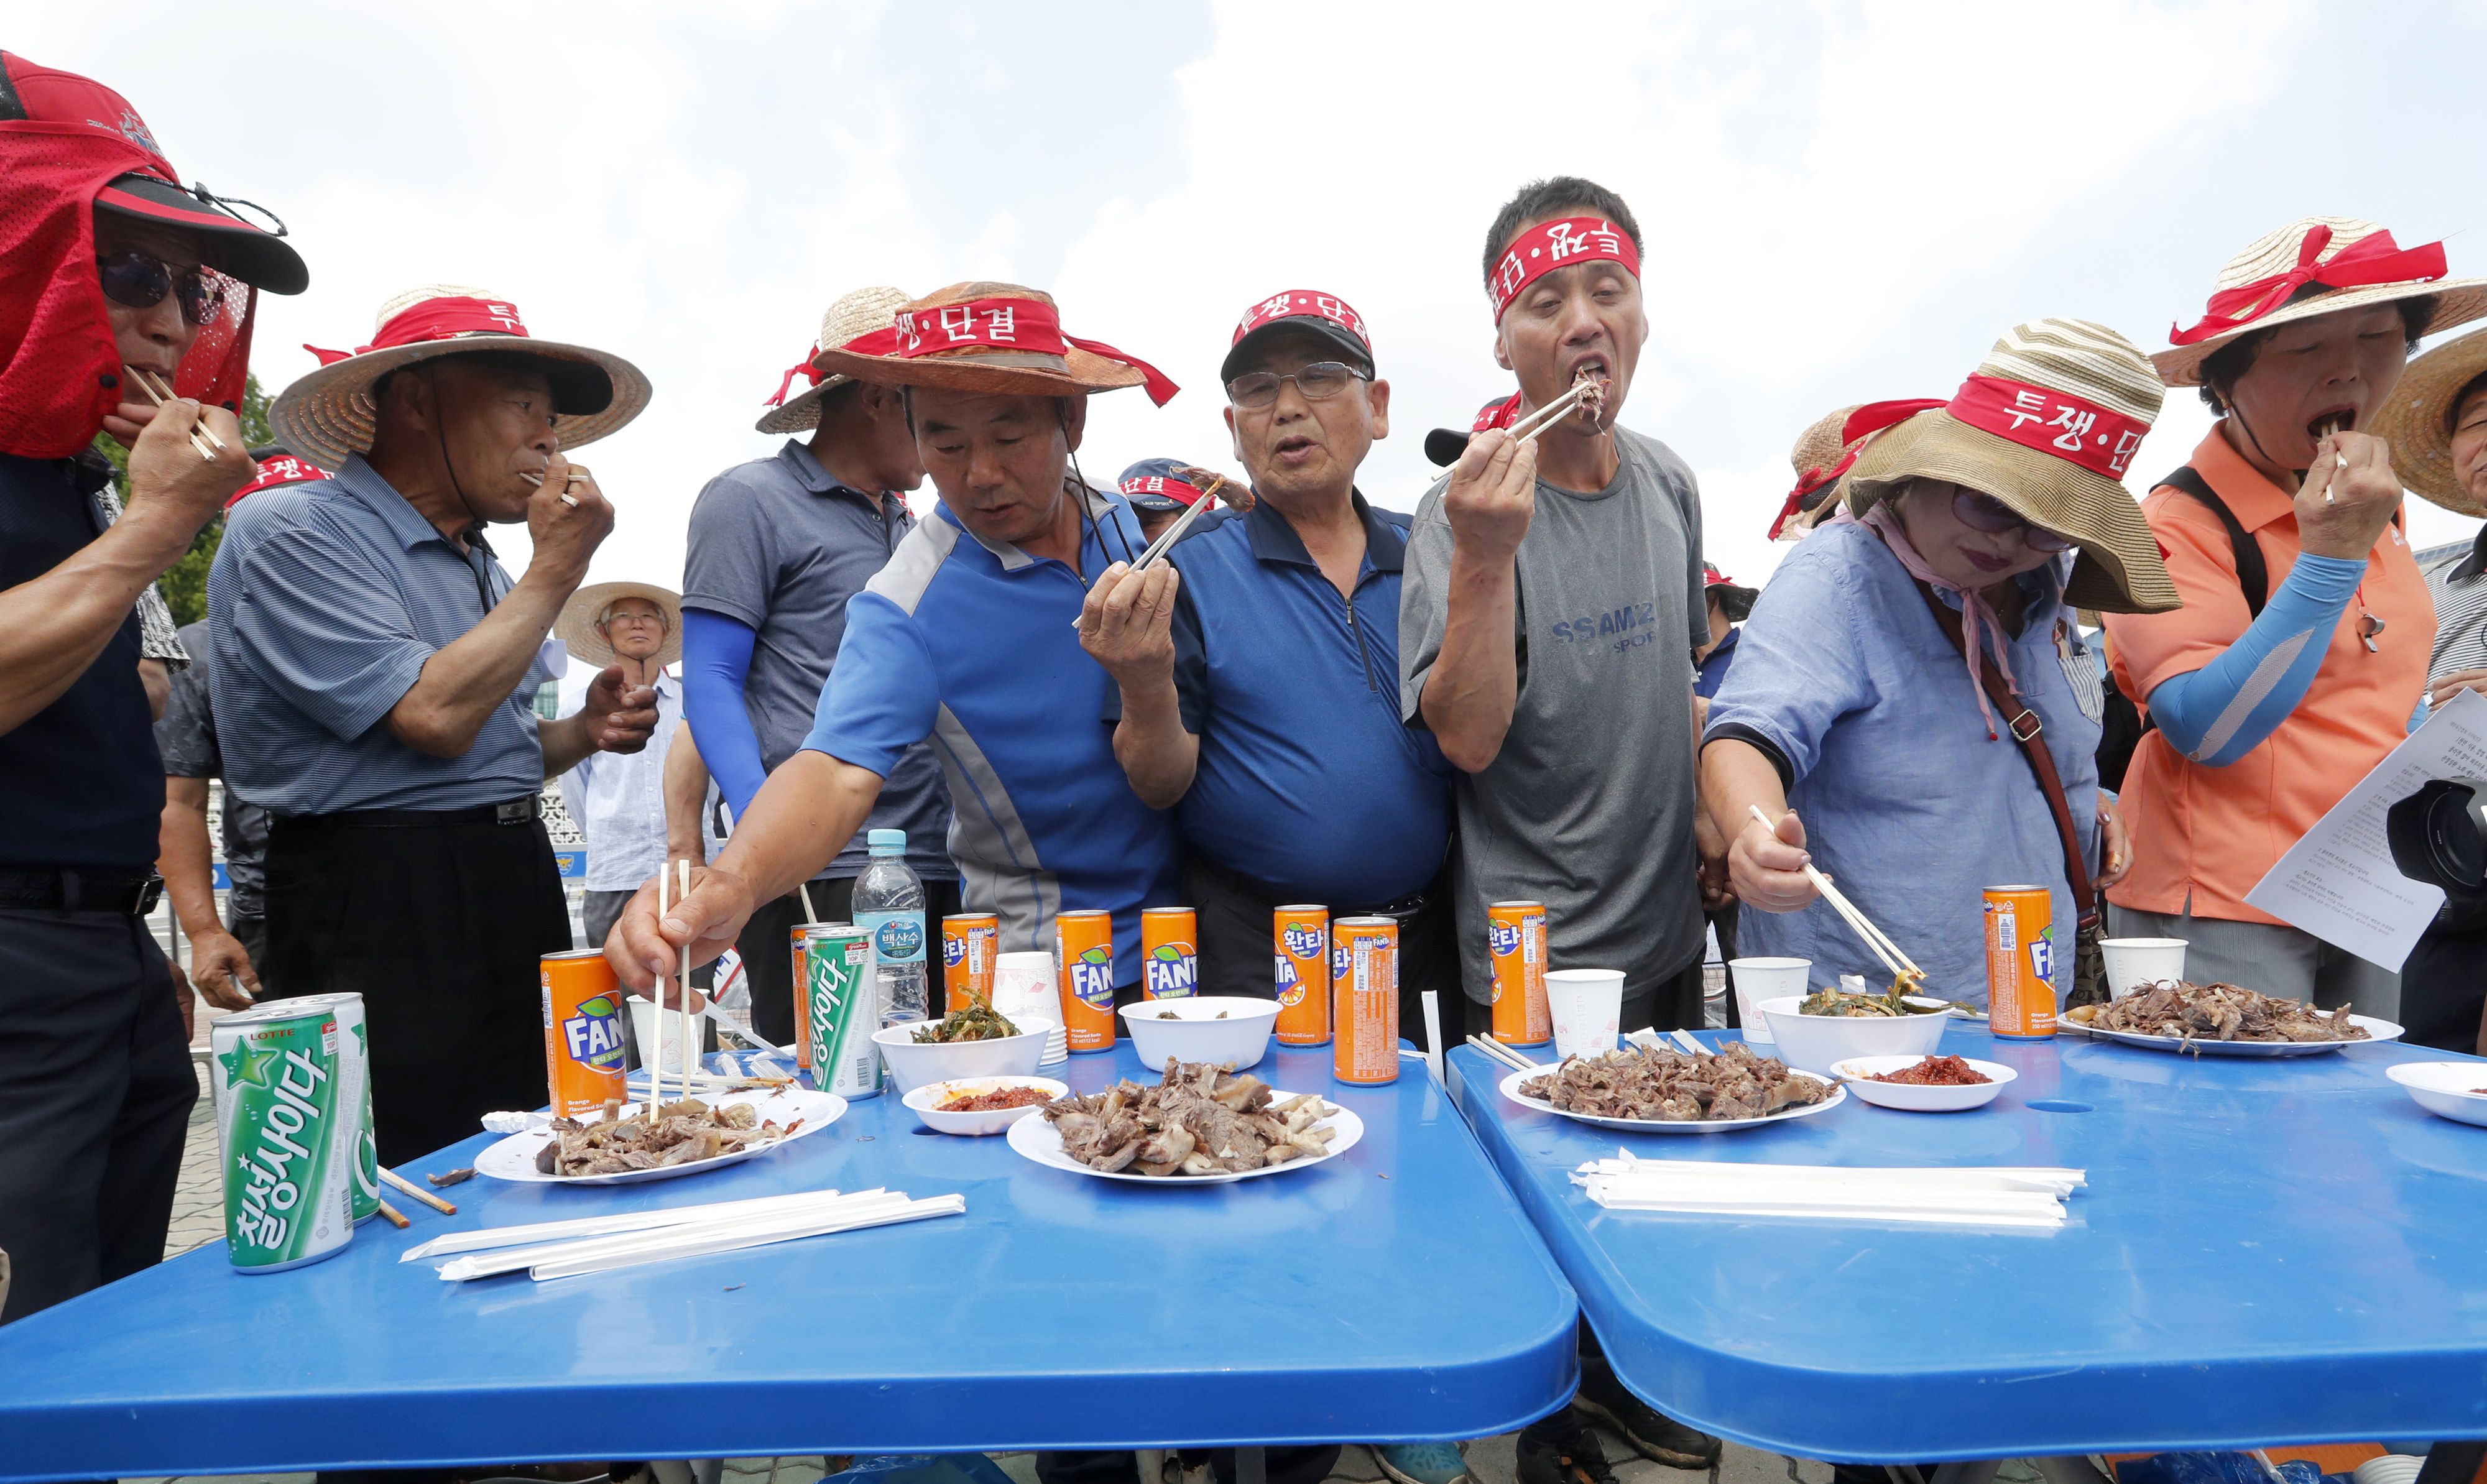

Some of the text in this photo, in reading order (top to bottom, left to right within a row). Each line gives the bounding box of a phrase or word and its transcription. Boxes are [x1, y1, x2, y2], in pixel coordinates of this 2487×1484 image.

[487, 304, 524, 330] 투
[882, 932, 919, 947] 백산수
[1283, 929, 1324, 952] 환타
[1275, 956, 1296, 984] TA
[250, 1028, 295, 1041] LOTTE
[568, 1104, 595, 1112] Flavored
[236, 1048, 328, 1250] 칠성사이다
